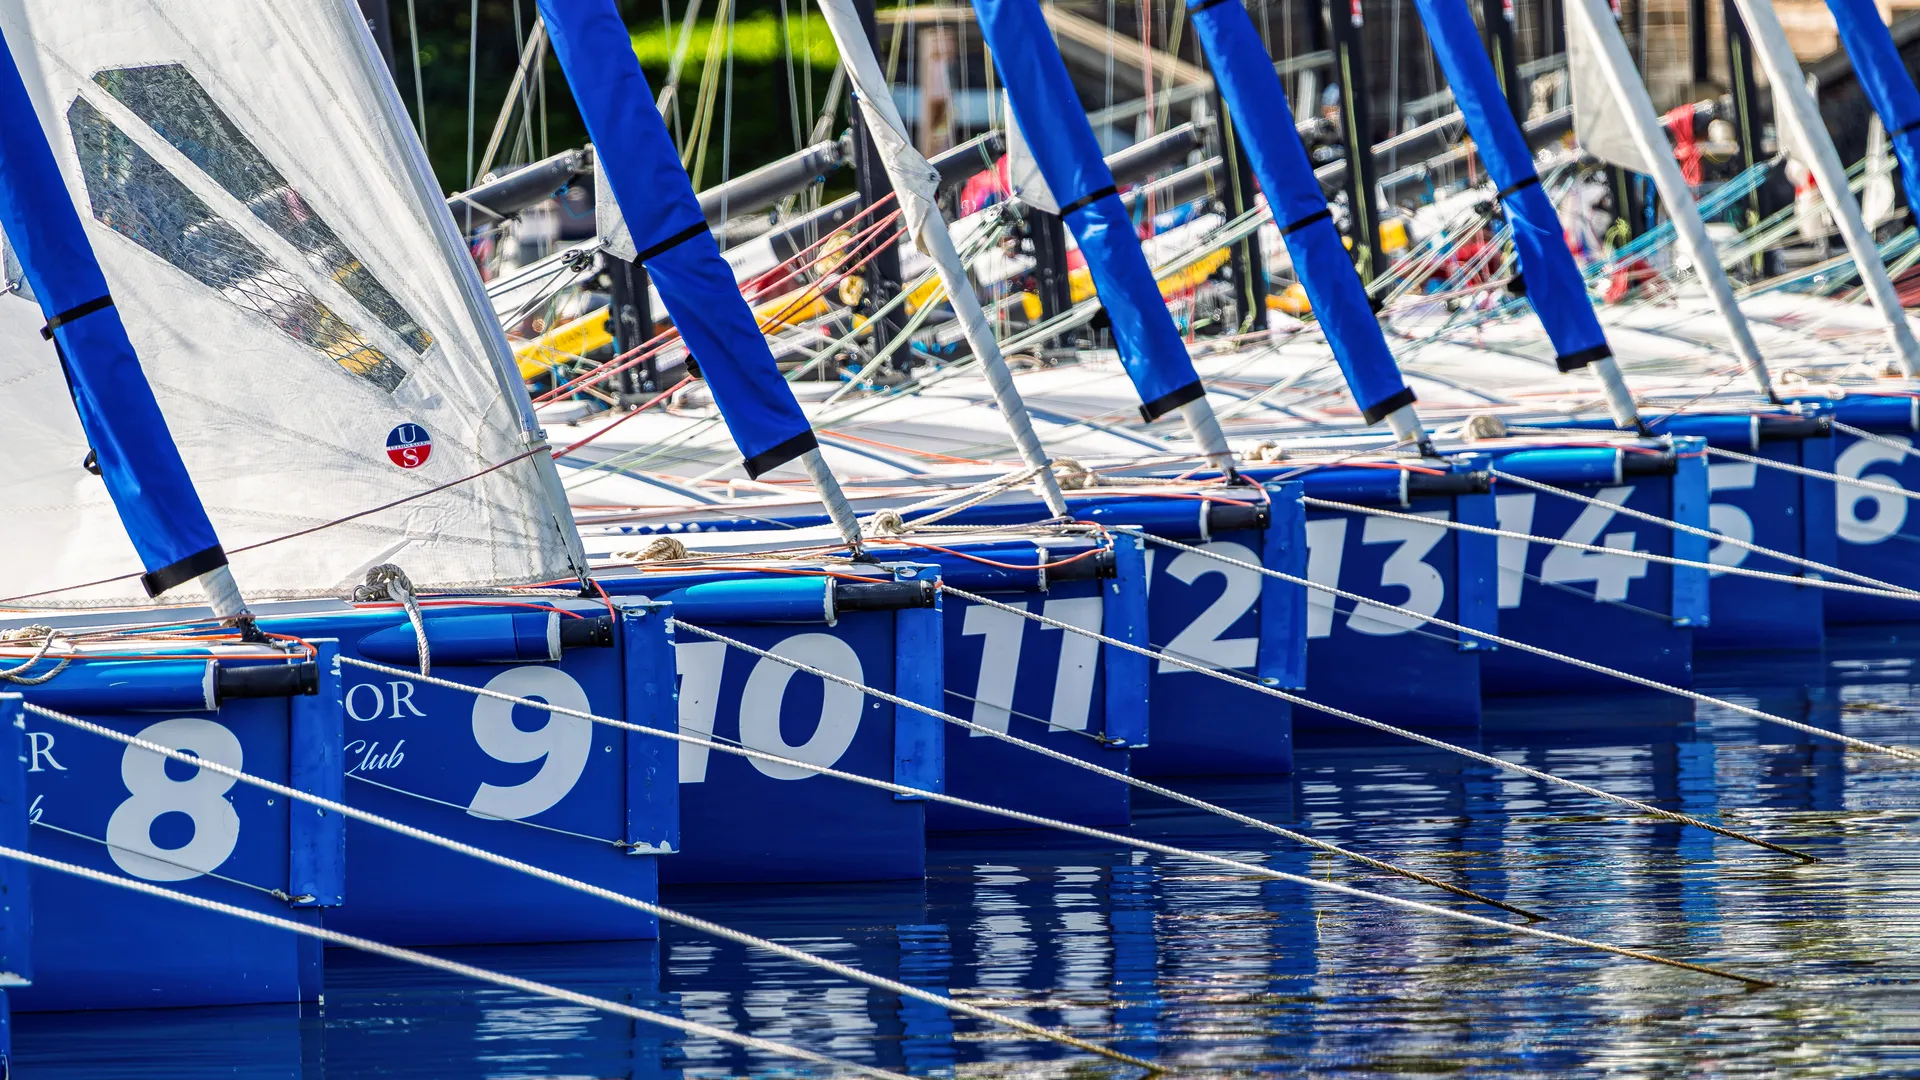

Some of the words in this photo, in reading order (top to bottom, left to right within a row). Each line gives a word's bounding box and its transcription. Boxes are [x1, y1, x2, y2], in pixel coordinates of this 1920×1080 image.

[398, 424, 416, 444] U
[402, 447, 419, 467] S
[1305, 510, 1449, 639] 13
[1495, 485, 1649, 609] 14
[345, 681, 427, 721] OR
[677, 632, 864, 784] 10
[962, 596, 1102, 738] 11
[106, 718, 243, 881] 8
[465, 666, 592, 820] 9
